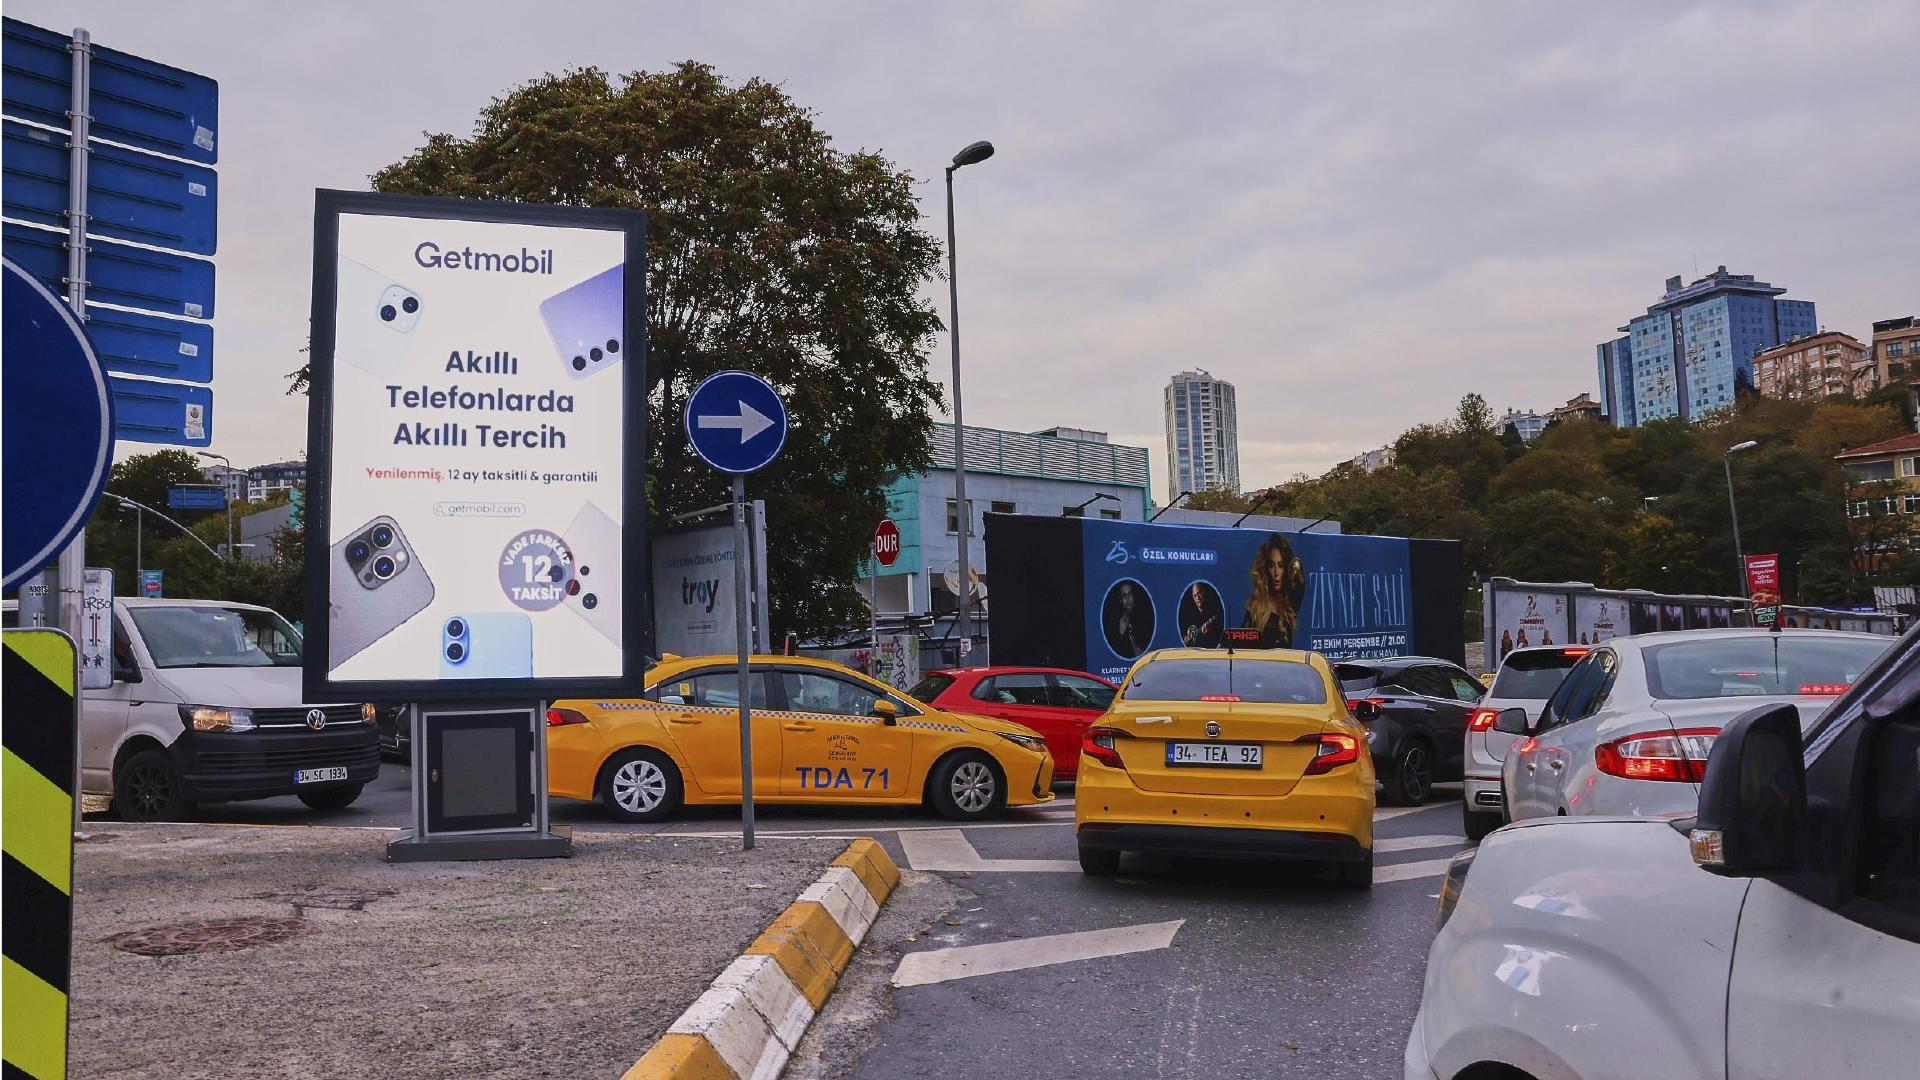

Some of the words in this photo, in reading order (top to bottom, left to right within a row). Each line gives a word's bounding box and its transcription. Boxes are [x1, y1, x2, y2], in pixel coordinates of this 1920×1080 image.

[414, 241, 553, 275] Getmobil
[445, 350, 518, 375] Akıllı
[385, 385, 574, 413] Telefonlarda
[393, 422, 467, 447] Akıllı
[475, 425, 566, 449] Tercih
[448, 469, 460, 480] 12
[463, 471, 479, 484] ay
[482, 469, 527, 481] taksitli
[530, 471, 539, 481] &
[542, 471, 598, 485] garantili
[448, 504, 521, 517] getmobil.com
[503, 536, 529, 566] VADE
[876, 534, 898, 553] DUR
[1105, 540, 1129, 565] 25
[1143, 548, 1166, 560] ÖZEL
[1167, 550, 1214, 561] KONUKLARI
[522, 554, 552, 583] 12
[511, 585, 562, 601] TAKSİT
[682, 577, 719, 614] troy
[1313, 640, 1322, 650] 23
[1324, 639, 1342, 649] EKİM
[1344, 637, 1380, 649] PERŞEMBE
[1175, 745, 1191, 761] 34
[1203, 746, 1228, 762] TEA
[1241, 747, 1258, 763] 92
[299, 770, 310, 782] 34
[795, 767, 853, 789] TDA
[862, 768, 889, 789] 71
